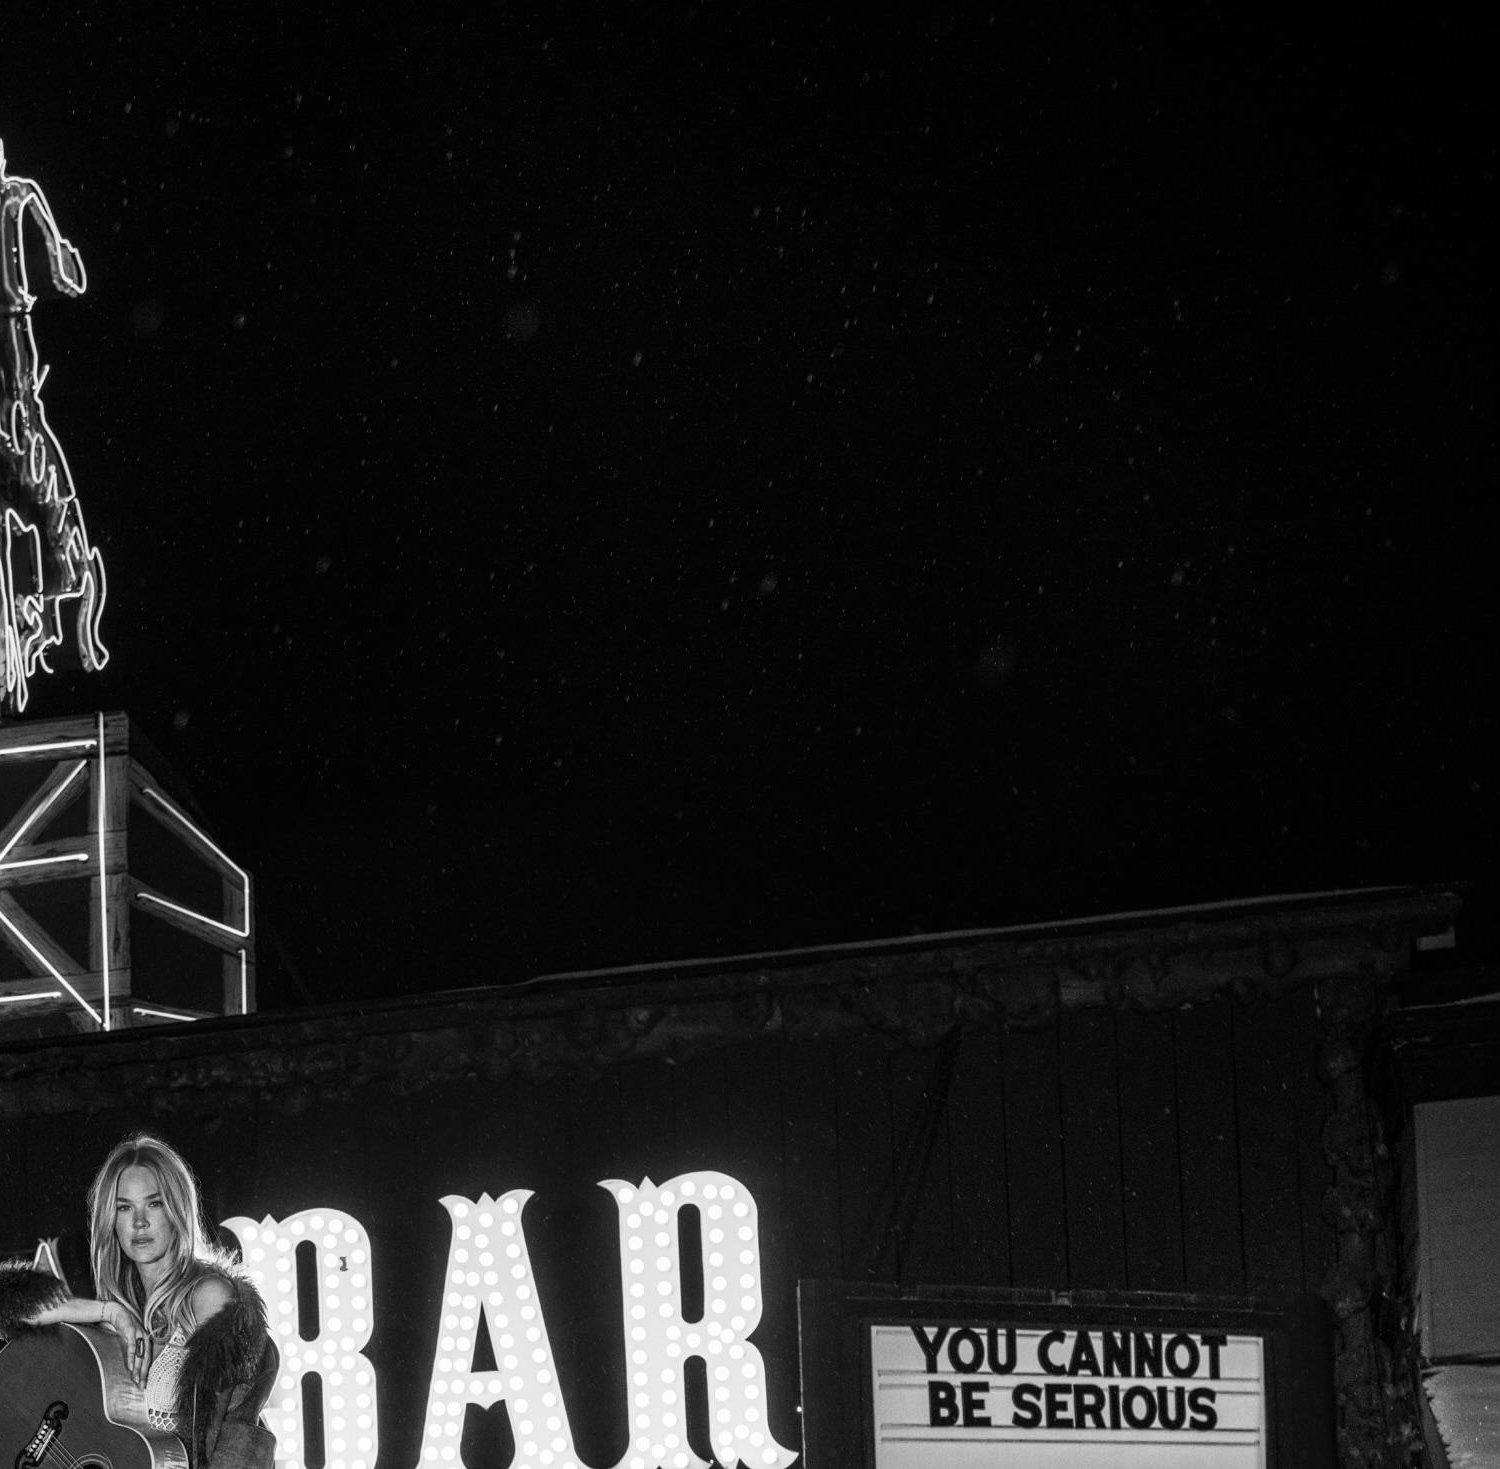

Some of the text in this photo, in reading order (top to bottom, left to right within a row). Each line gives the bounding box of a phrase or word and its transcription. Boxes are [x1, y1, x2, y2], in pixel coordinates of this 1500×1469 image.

[911, 1326, 1228, 1379] YOU CANNOT
[927, 1381, 1218, 1431] BE SERIOUS
